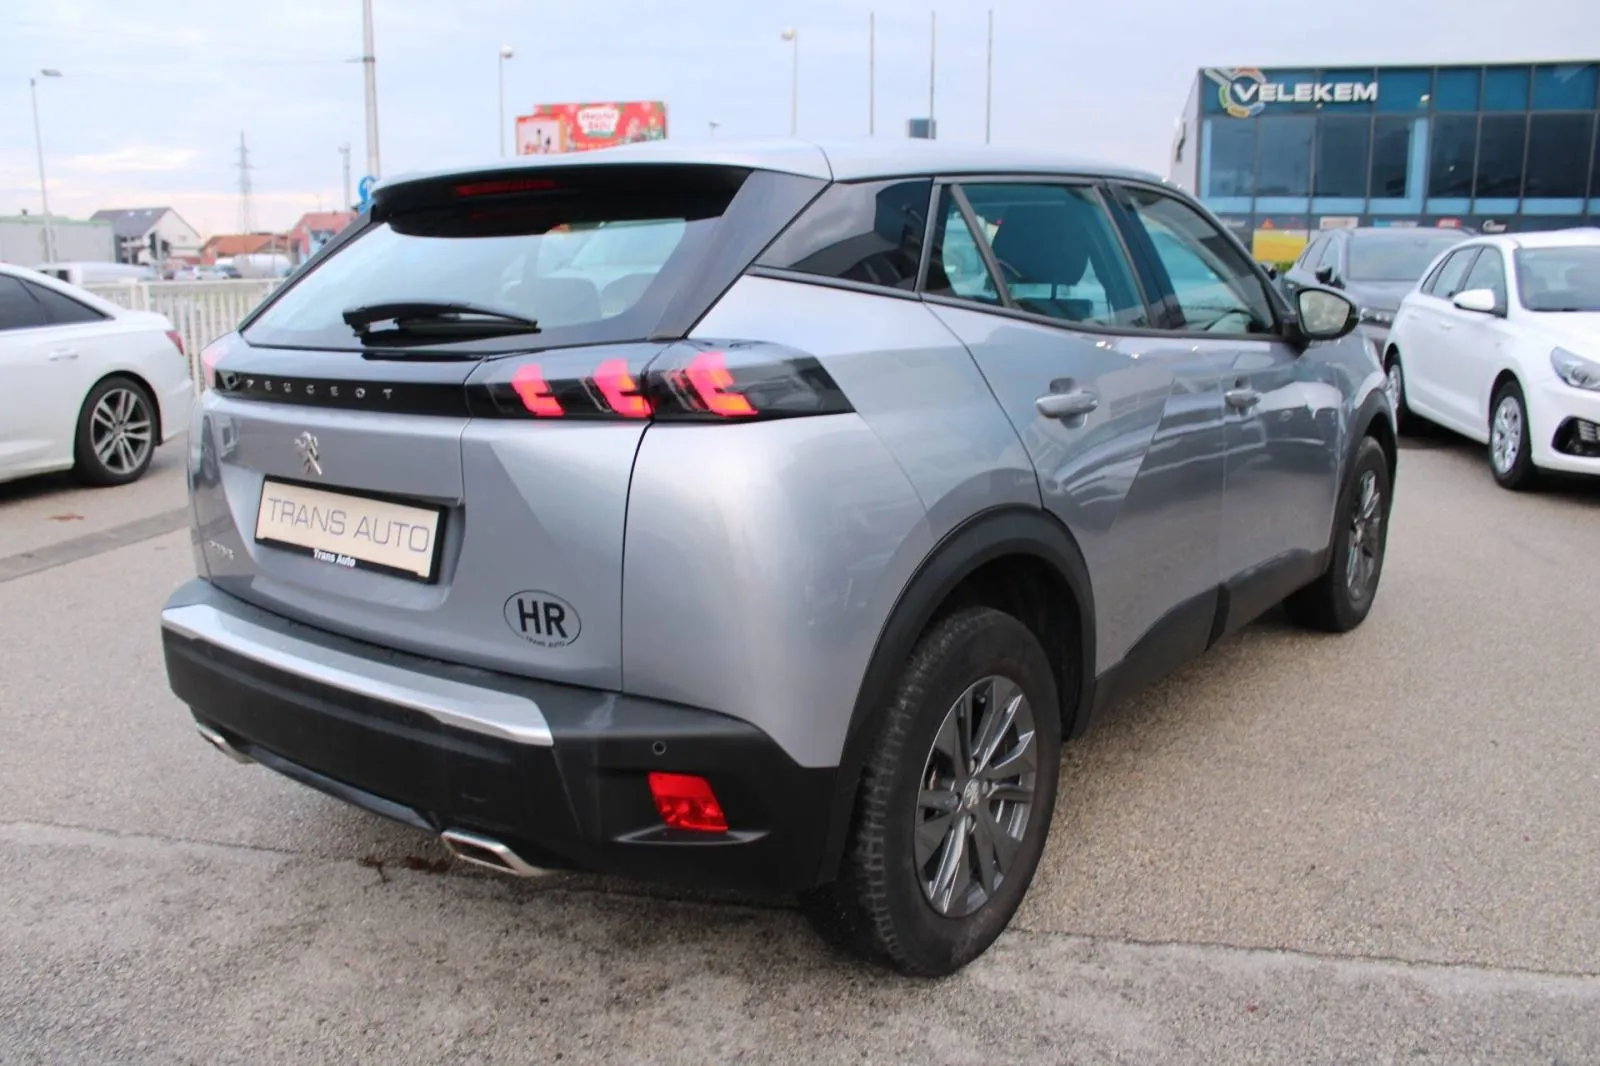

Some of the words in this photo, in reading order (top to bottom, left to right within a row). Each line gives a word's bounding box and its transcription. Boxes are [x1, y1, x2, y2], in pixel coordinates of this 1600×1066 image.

[1233, 82, 1378, 102] VELEKEM
[246, 378, 393, 400] PEUGEOT
[268, 498, 347, 536] TRANS
[353, 515, 431, 553] AUTO
[314, 548, 336, 564] Trans
[335, 553, 356, 568] Auto
[517, 598, 569, 639] HR
